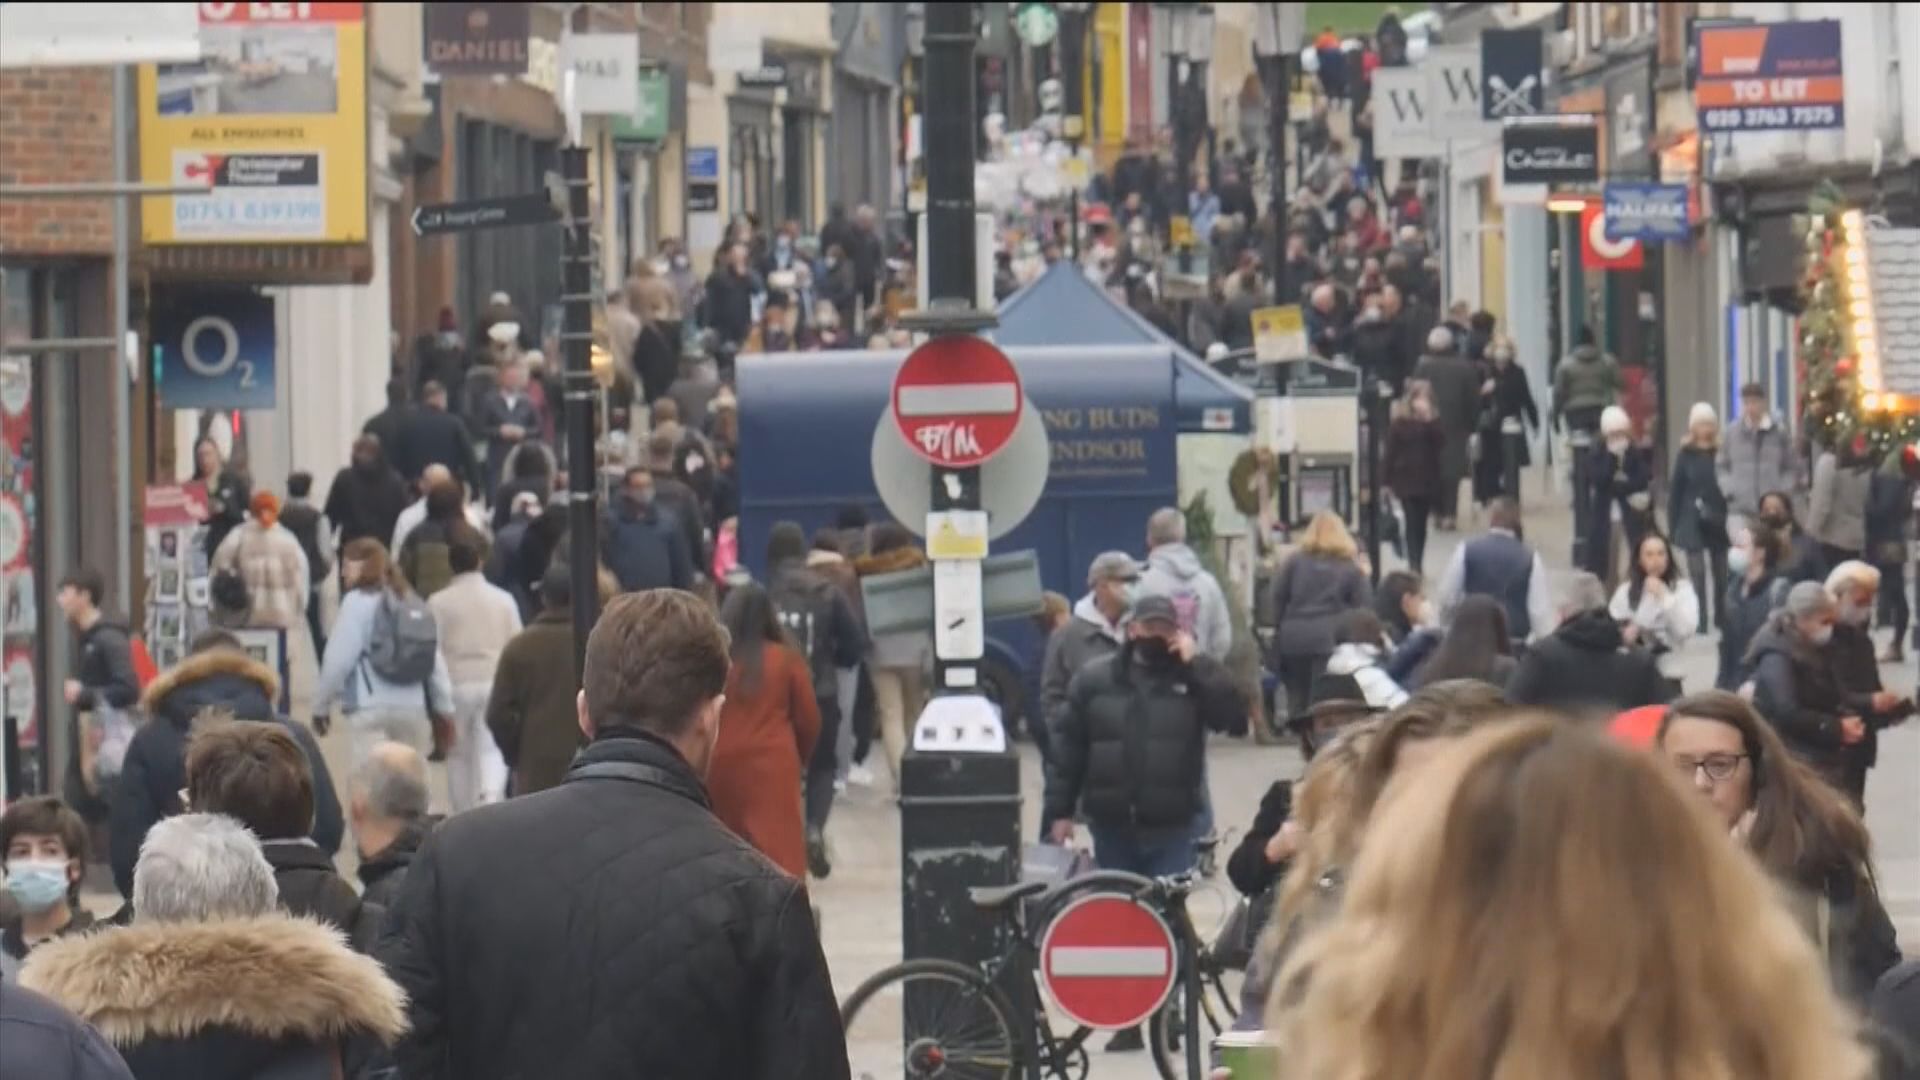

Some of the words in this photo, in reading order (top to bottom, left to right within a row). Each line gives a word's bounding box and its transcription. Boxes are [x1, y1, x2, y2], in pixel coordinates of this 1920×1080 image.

[430, 40, 527, 61] DANIEL
[1732, 79, 1764, 102] TO
[1771, 78, 1808, 101] LET
[1606, 203, 1686, 219] HALIFAX
[1041, 408, 1081, 429] NG
[1088, 407, 1159, 429] BUDS
[1050, 439, 1145, 460] INDSOR
